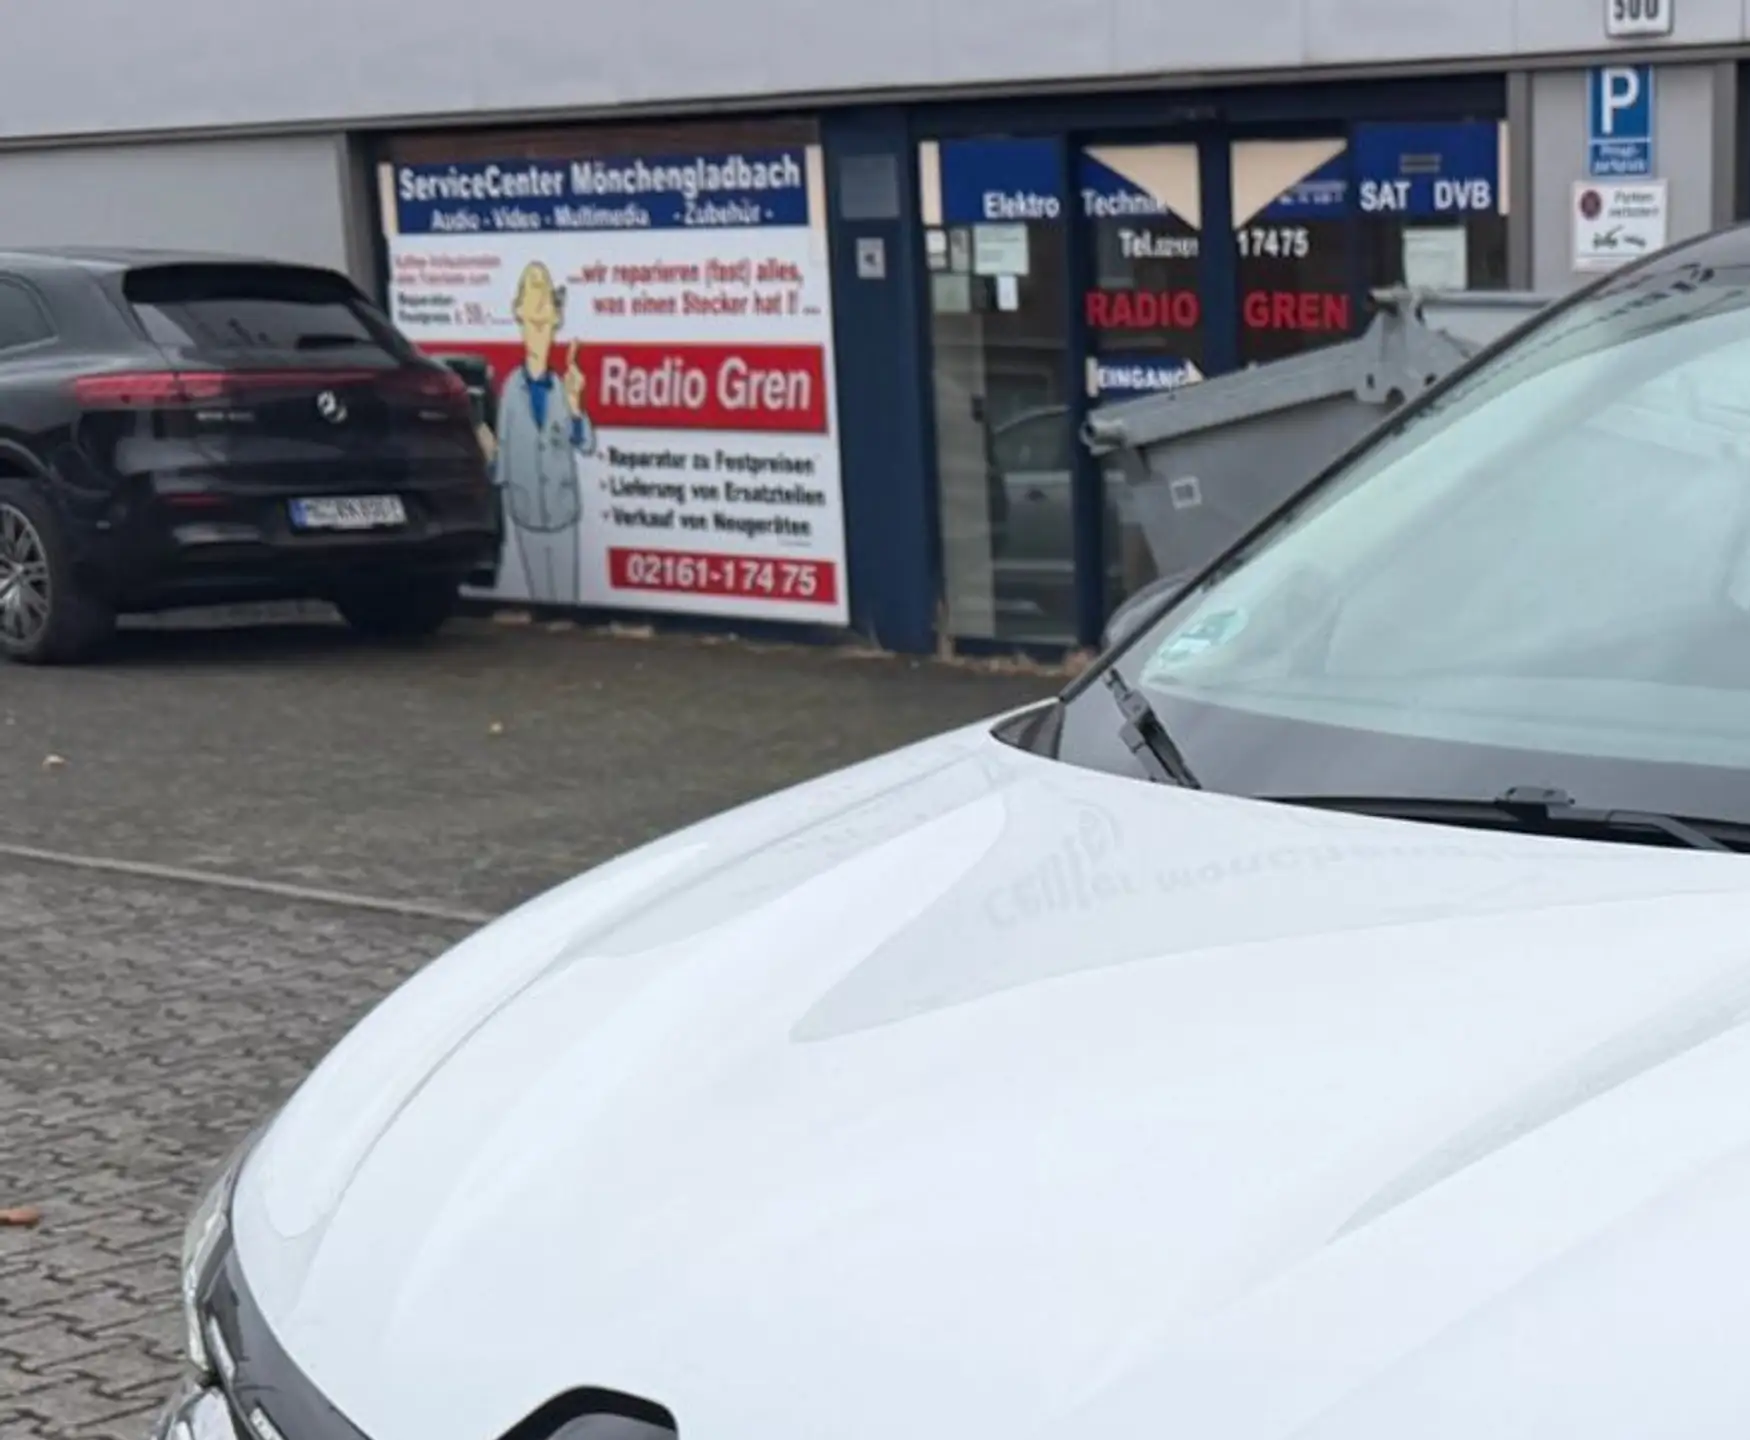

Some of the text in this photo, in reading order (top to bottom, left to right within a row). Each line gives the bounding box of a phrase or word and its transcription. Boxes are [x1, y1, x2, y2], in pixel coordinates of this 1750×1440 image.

[1602, 67, 1640, 134] P
[400, 153, 800, 201] ServiceCenter Mönchengladbach
[982, 189, 1060, 219] Elektro
[1360, 180, 1410, 211] SAT
[1433, 179, 1492, 210] DVB
[1237, 229, 1309, 257] 17475
[1086, 293, 1350, 329] RADIO GREN
[600, 355, 812, 411] Radio Gren
